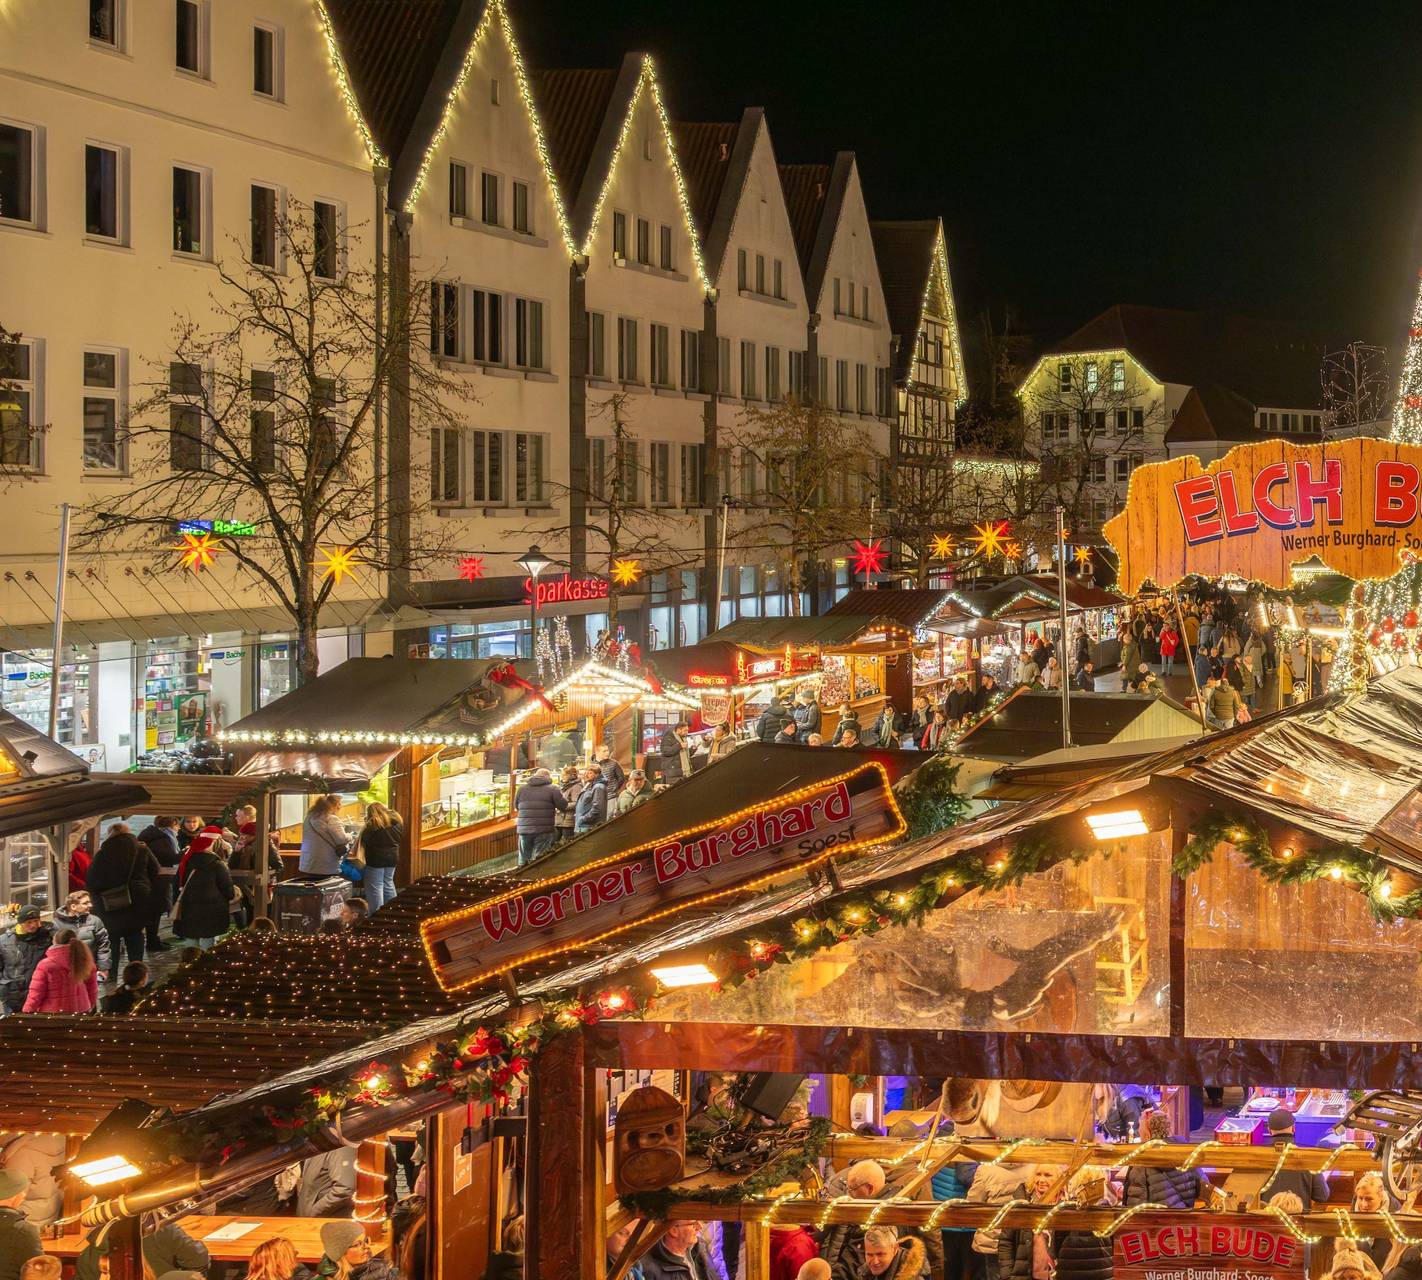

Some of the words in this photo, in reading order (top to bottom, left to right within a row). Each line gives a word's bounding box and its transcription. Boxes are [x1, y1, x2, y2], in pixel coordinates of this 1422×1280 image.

[1174, 459, 1344, 543] ELCH
[1281, 534, 1330, 551] Werner
[524, 573, 608, 609] Sparkasse
[799, 823, 857, 859] Soest
[481, 862, 643, 941] Werner
[653, 781, 853, 883] Burghard
[1120, 1226, 1200, 1264] ELCH
[1210, 1226, 1296, 1267] BUDE
[1145, 1270, 1186, 1280] Werner
